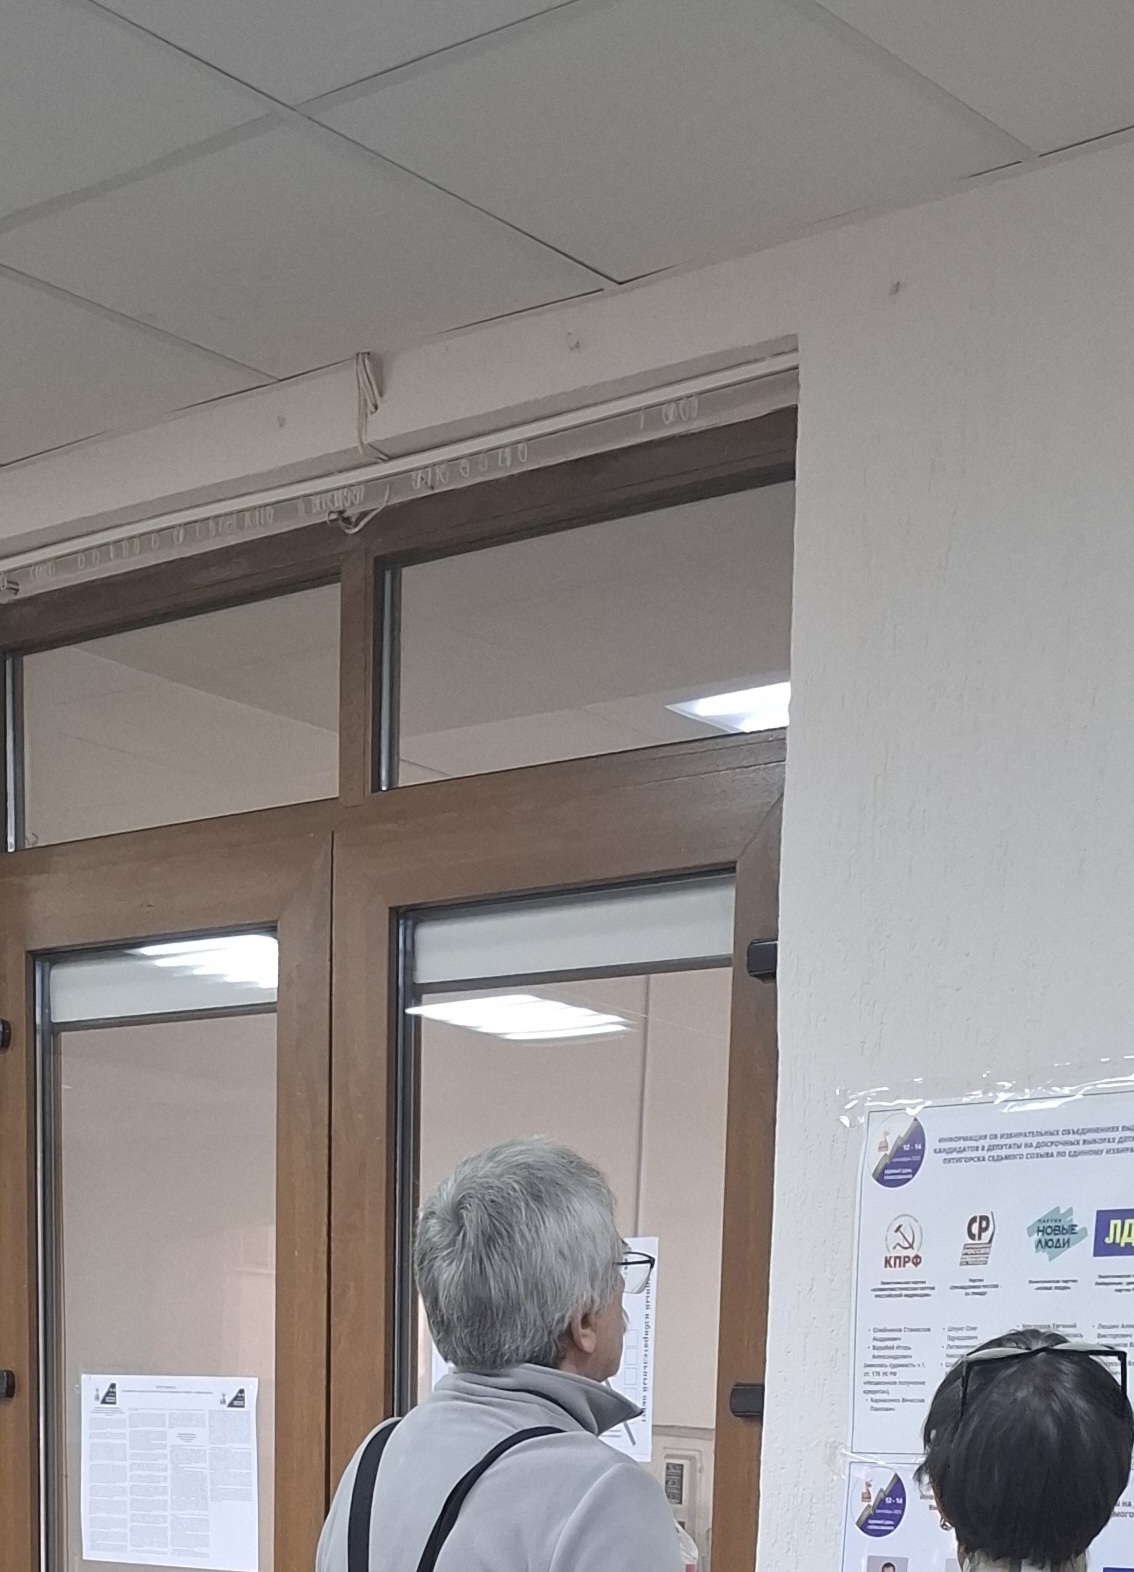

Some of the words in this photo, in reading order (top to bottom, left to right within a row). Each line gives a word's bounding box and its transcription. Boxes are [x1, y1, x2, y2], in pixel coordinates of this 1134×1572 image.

[1000, 1129, 1060, 1140] ИЗБИРАТЕЛЬНЫХ
[933, 1145, 980, 1155] КАНДИДАТОВ
[986, 1143, 1022, 1152] ДЕПУТАТЫ
[1034, 1139, 1080, 1149] ДОСРОЧНЫХ
[1082, 1137, 1116, 1146] ВЫБОРАХ
[943, 1155, 986, 1164] ПЯТИГОРСКА
[987, 1153, 1024, 1162] СЕДЬМОГО
[1026, 1152, 1055, 1160] СОЗЫВА
[1068, 1149, 1104, 1158] ЕДИНОМУ
[967, 1215, 991, 1241] СР
[1036, 1224, 1079, 1237] НОВЫЕ
[1035, 1237, 1071, 1250] ЛЮДИ
[884, 1253, 922, 1269] КПРФ
